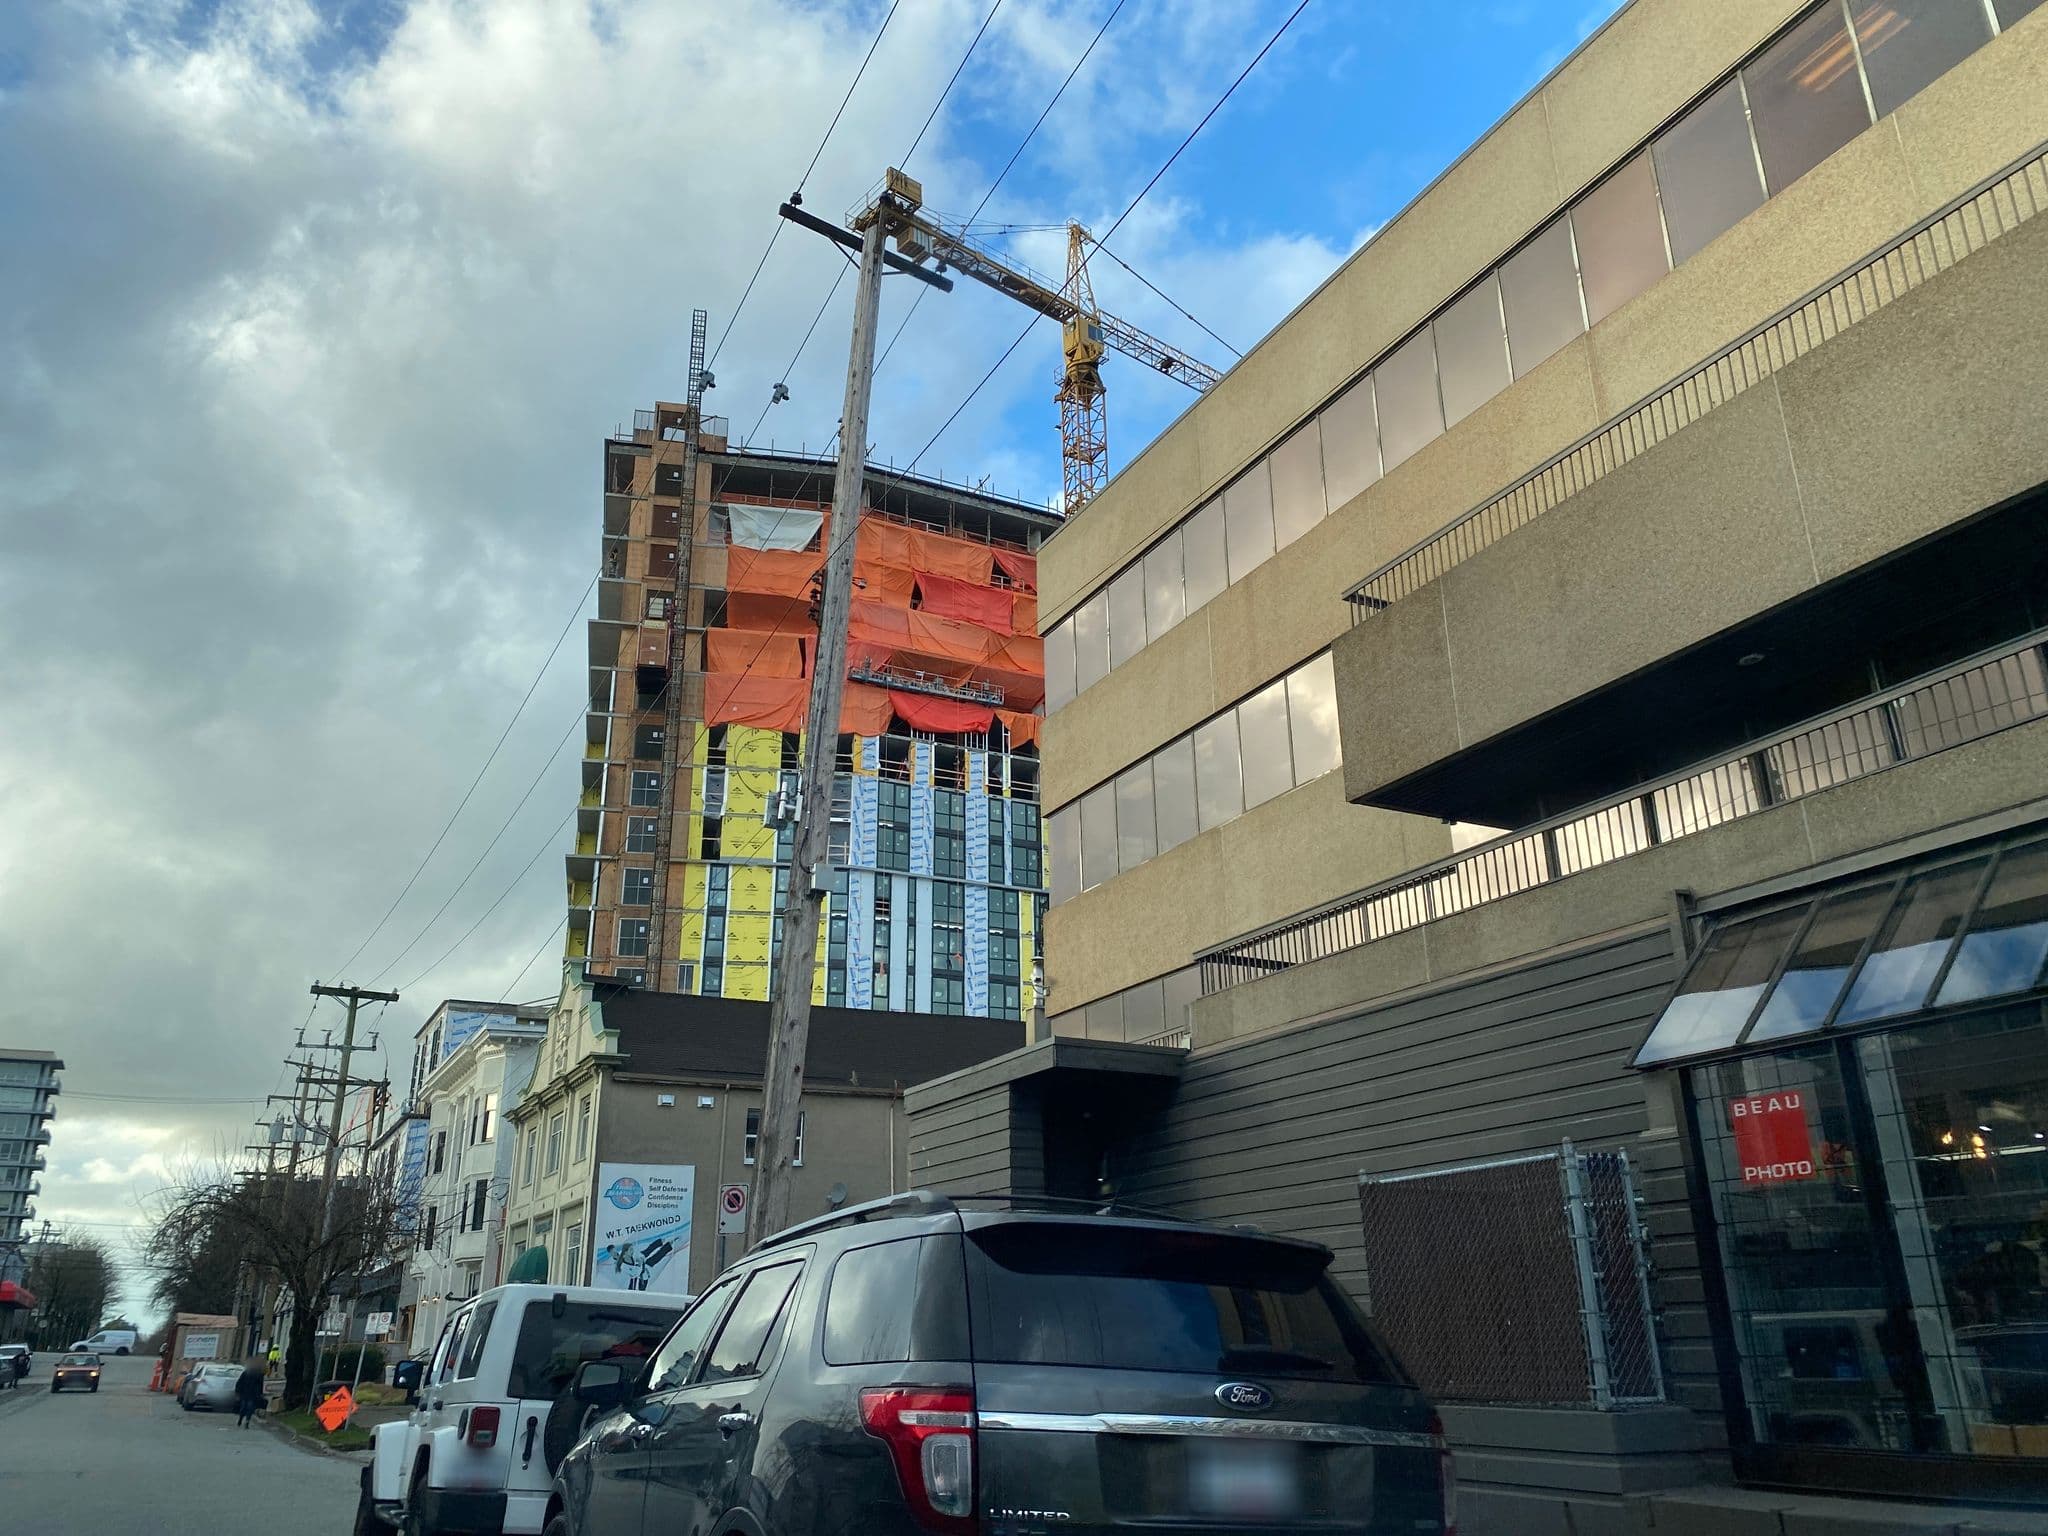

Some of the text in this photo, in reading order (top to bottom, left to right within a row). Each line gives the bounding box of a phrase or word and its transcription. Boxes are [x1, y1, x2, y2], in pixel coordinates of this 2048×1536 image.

[1733, 1094, 1800, 1117] BEAU
[1744, 1160, 1812, 1181] PHOTO
[605, 1214, 681, 1239] W.T. TAEKWONDO
[1230, 1386, 1263, 1404] Ford
[989, 1508, 1071, 1521] LIMITED
